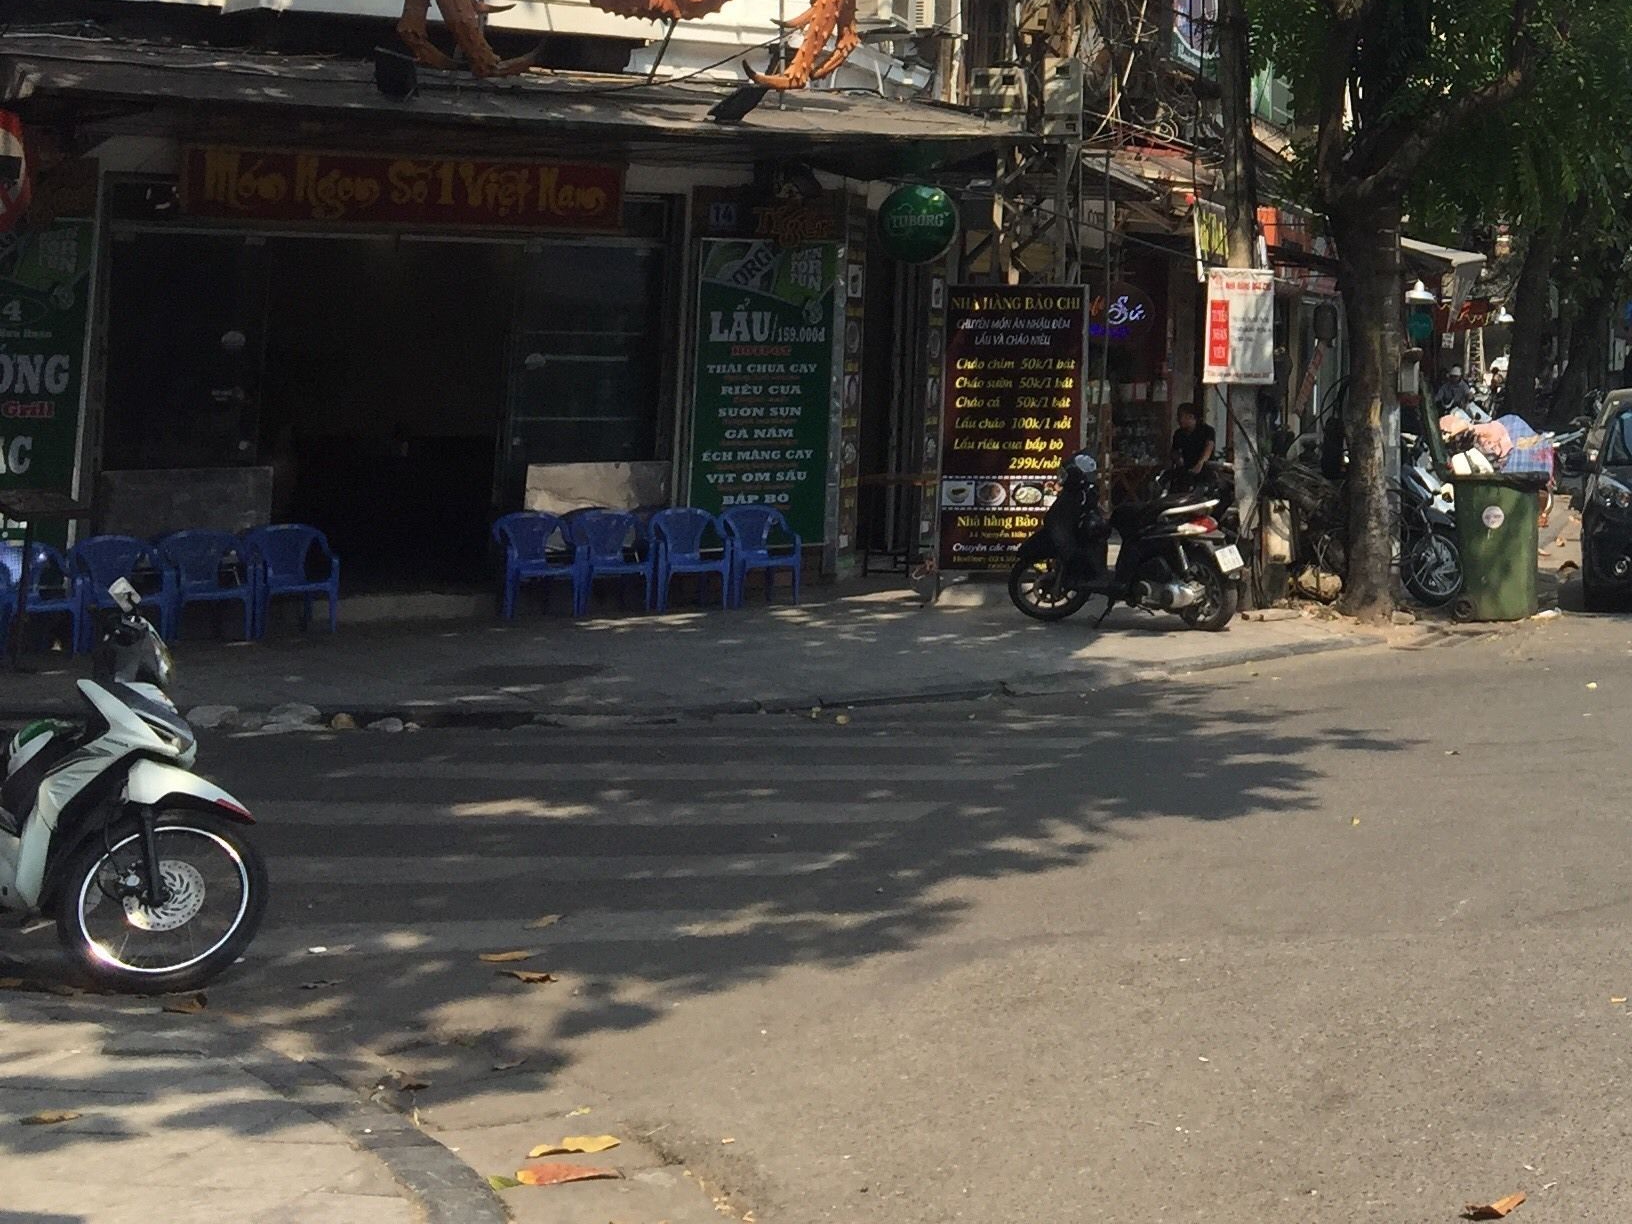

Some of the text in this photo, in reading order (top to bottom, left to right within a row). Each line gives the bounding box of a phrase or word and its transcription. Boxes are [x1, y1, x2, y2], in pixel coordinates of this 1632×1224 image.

[890, 214, 945, 228] TUBORG
[789, 363, 818, 374] CAY
[767, 384, 802, 395] CUA
[785, 449, 814, 460] CAY
[741, 472, 771, 482] OM
